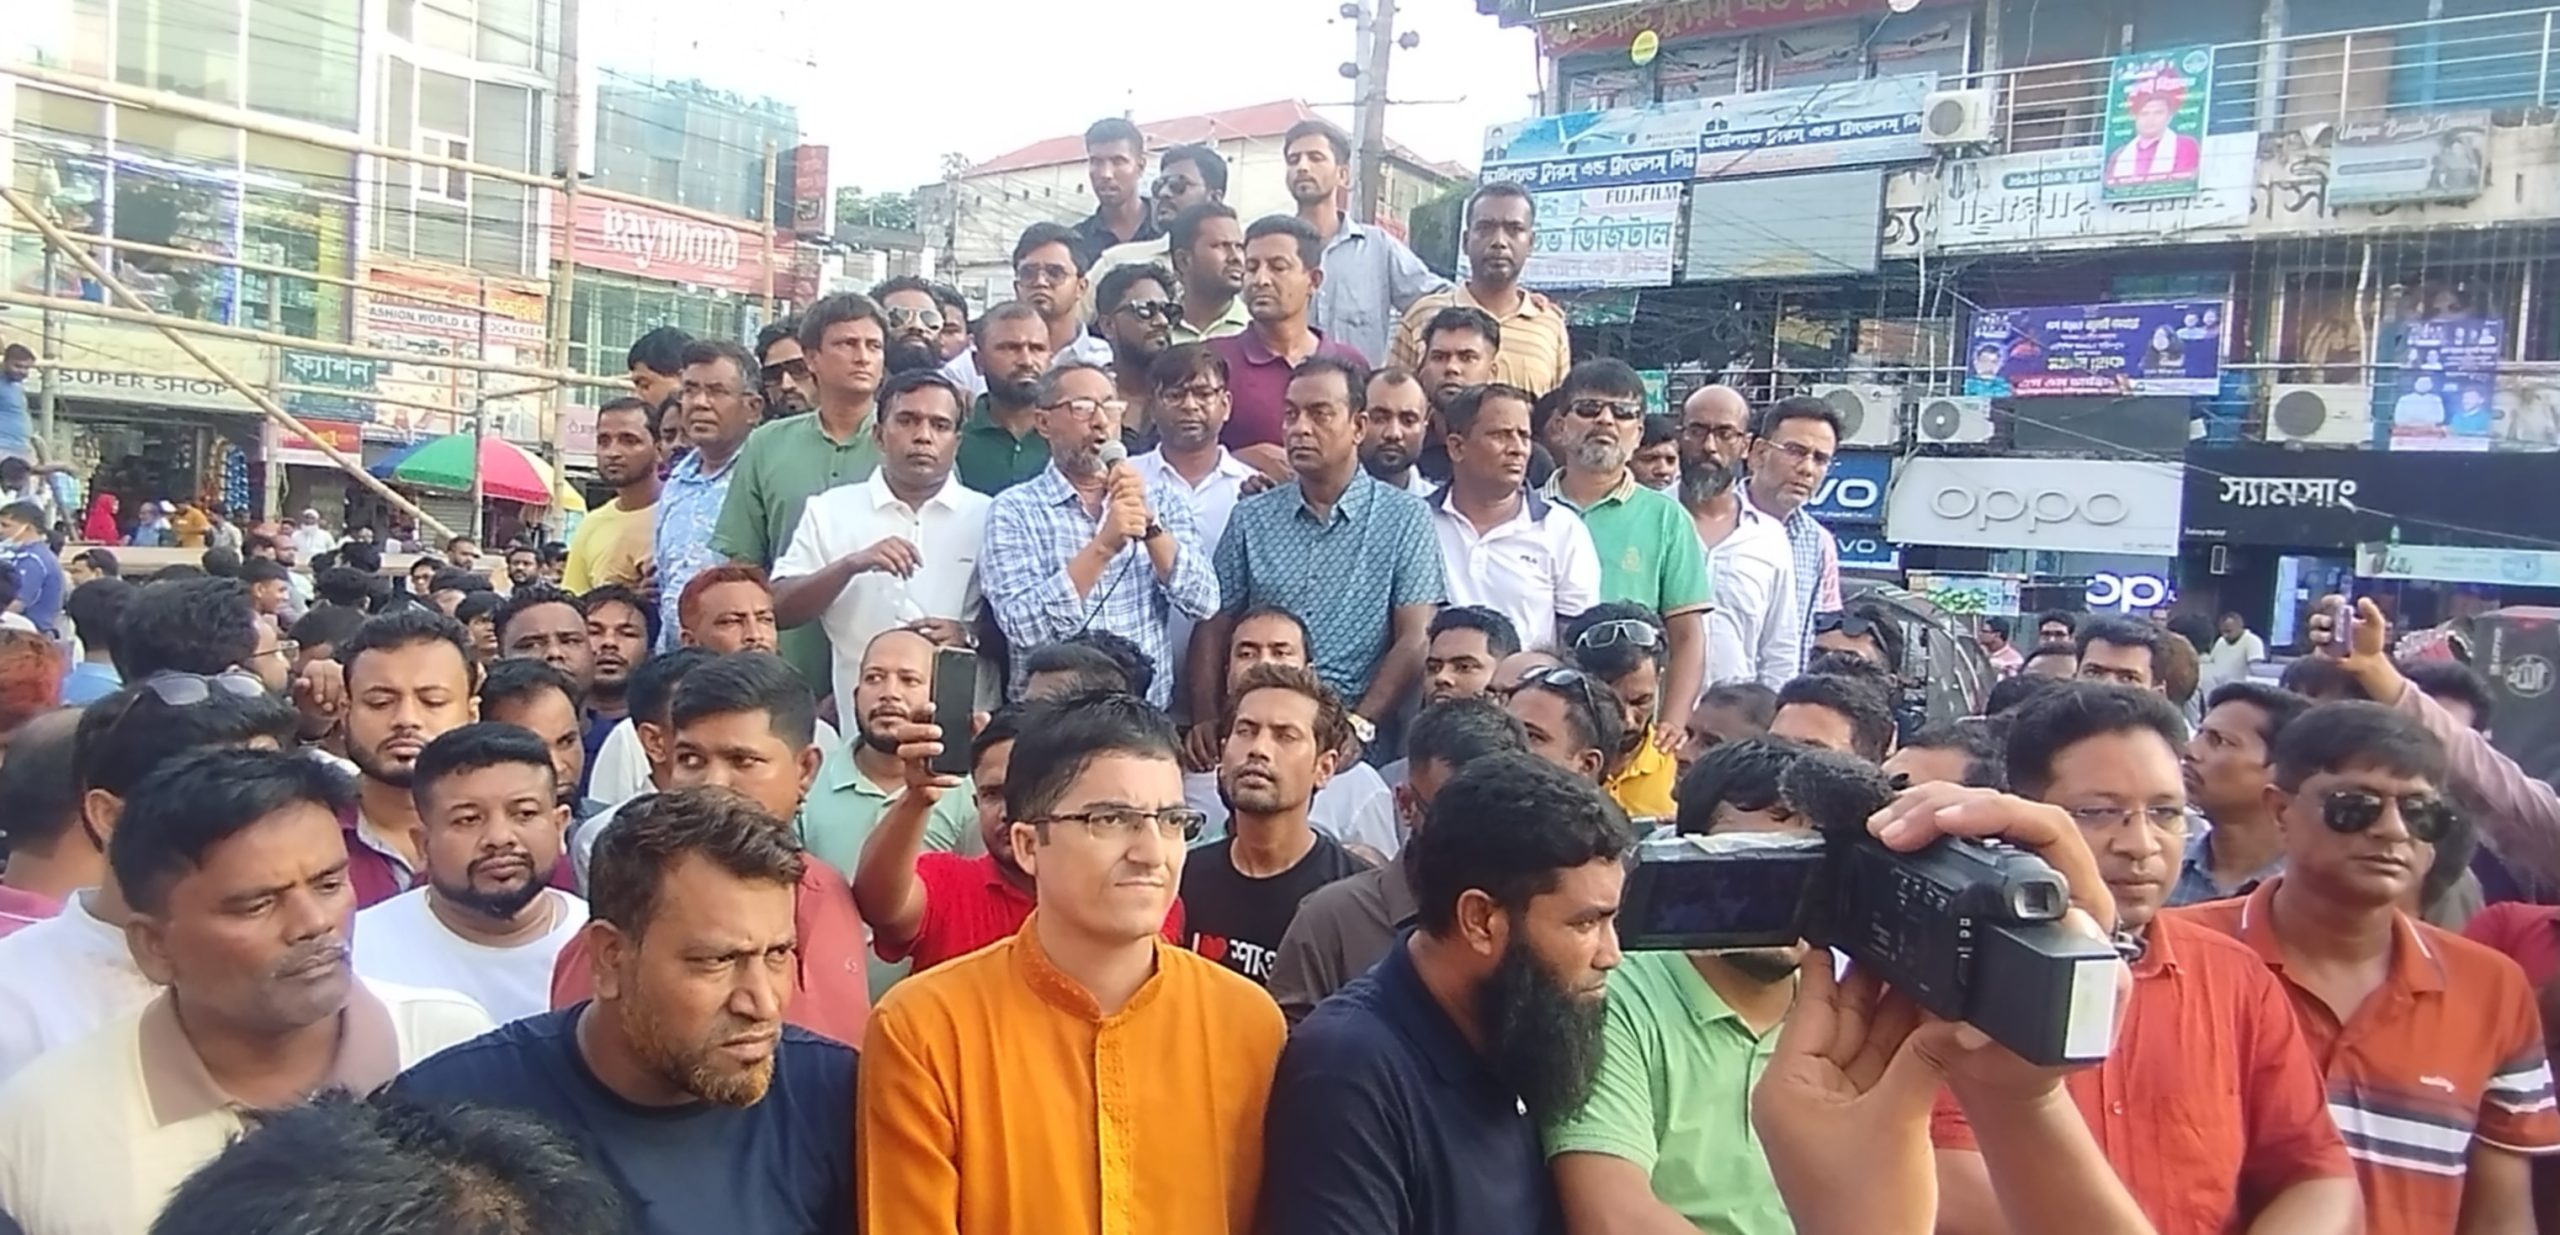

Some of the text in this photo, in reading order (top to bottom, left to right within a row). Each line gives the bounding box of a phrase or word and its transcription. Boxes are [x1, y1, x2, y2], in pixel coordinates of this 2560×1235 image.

[1903, 114, 1923, 129] লি
[1570, 215, 1674, 252] ডিজিটাল
[368, 307, 416, 322] ASHION
[418, 312, 459, 327] WORLD
[59, 368, 228, 397] SUPER SHOP
[287, 353, 373, 383] ফ্যাশন
[2219, 476, 2357, 512] স্যামসাং
[1931, 486, 2130, 534] oppo
